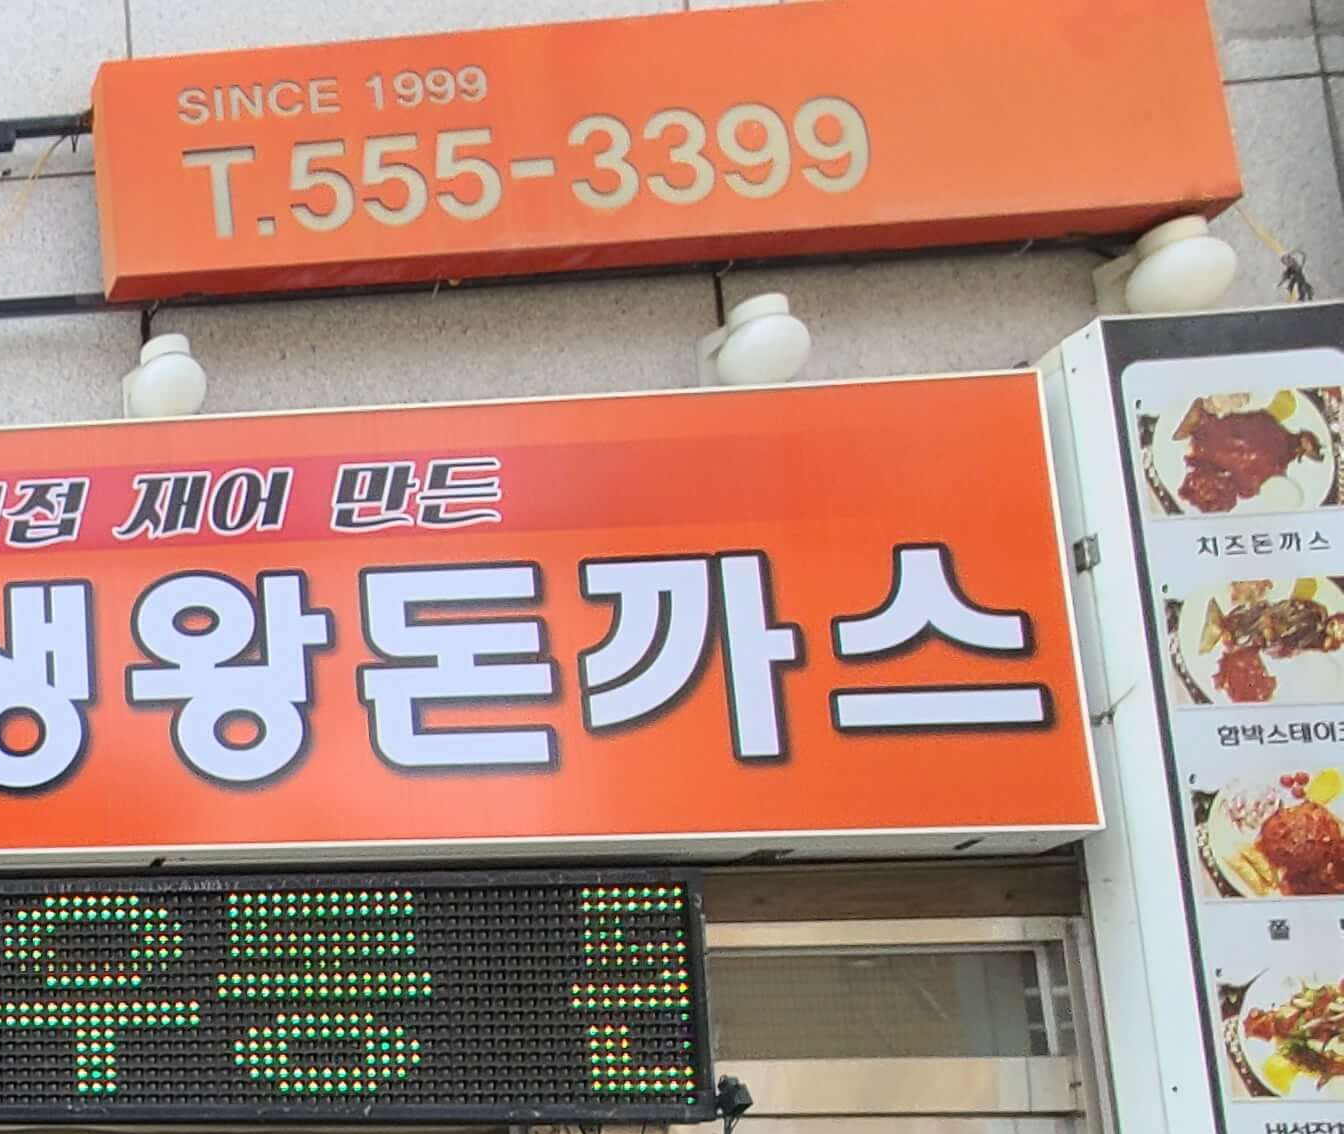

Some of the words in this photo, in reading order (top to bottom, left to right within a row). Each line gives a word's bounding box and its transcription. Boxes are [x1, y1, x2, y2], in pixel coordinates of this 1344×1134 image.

[177, 78, 340, 126] SINCE
[364, 65, 489, 110] 1999
[182, 96, 871, 240] T.555-3399
[114, 467, 293, 538] 재어
[331, 457, 502, 531] 만든
[1196, 531, 1330, 557] 치즈돈까스
